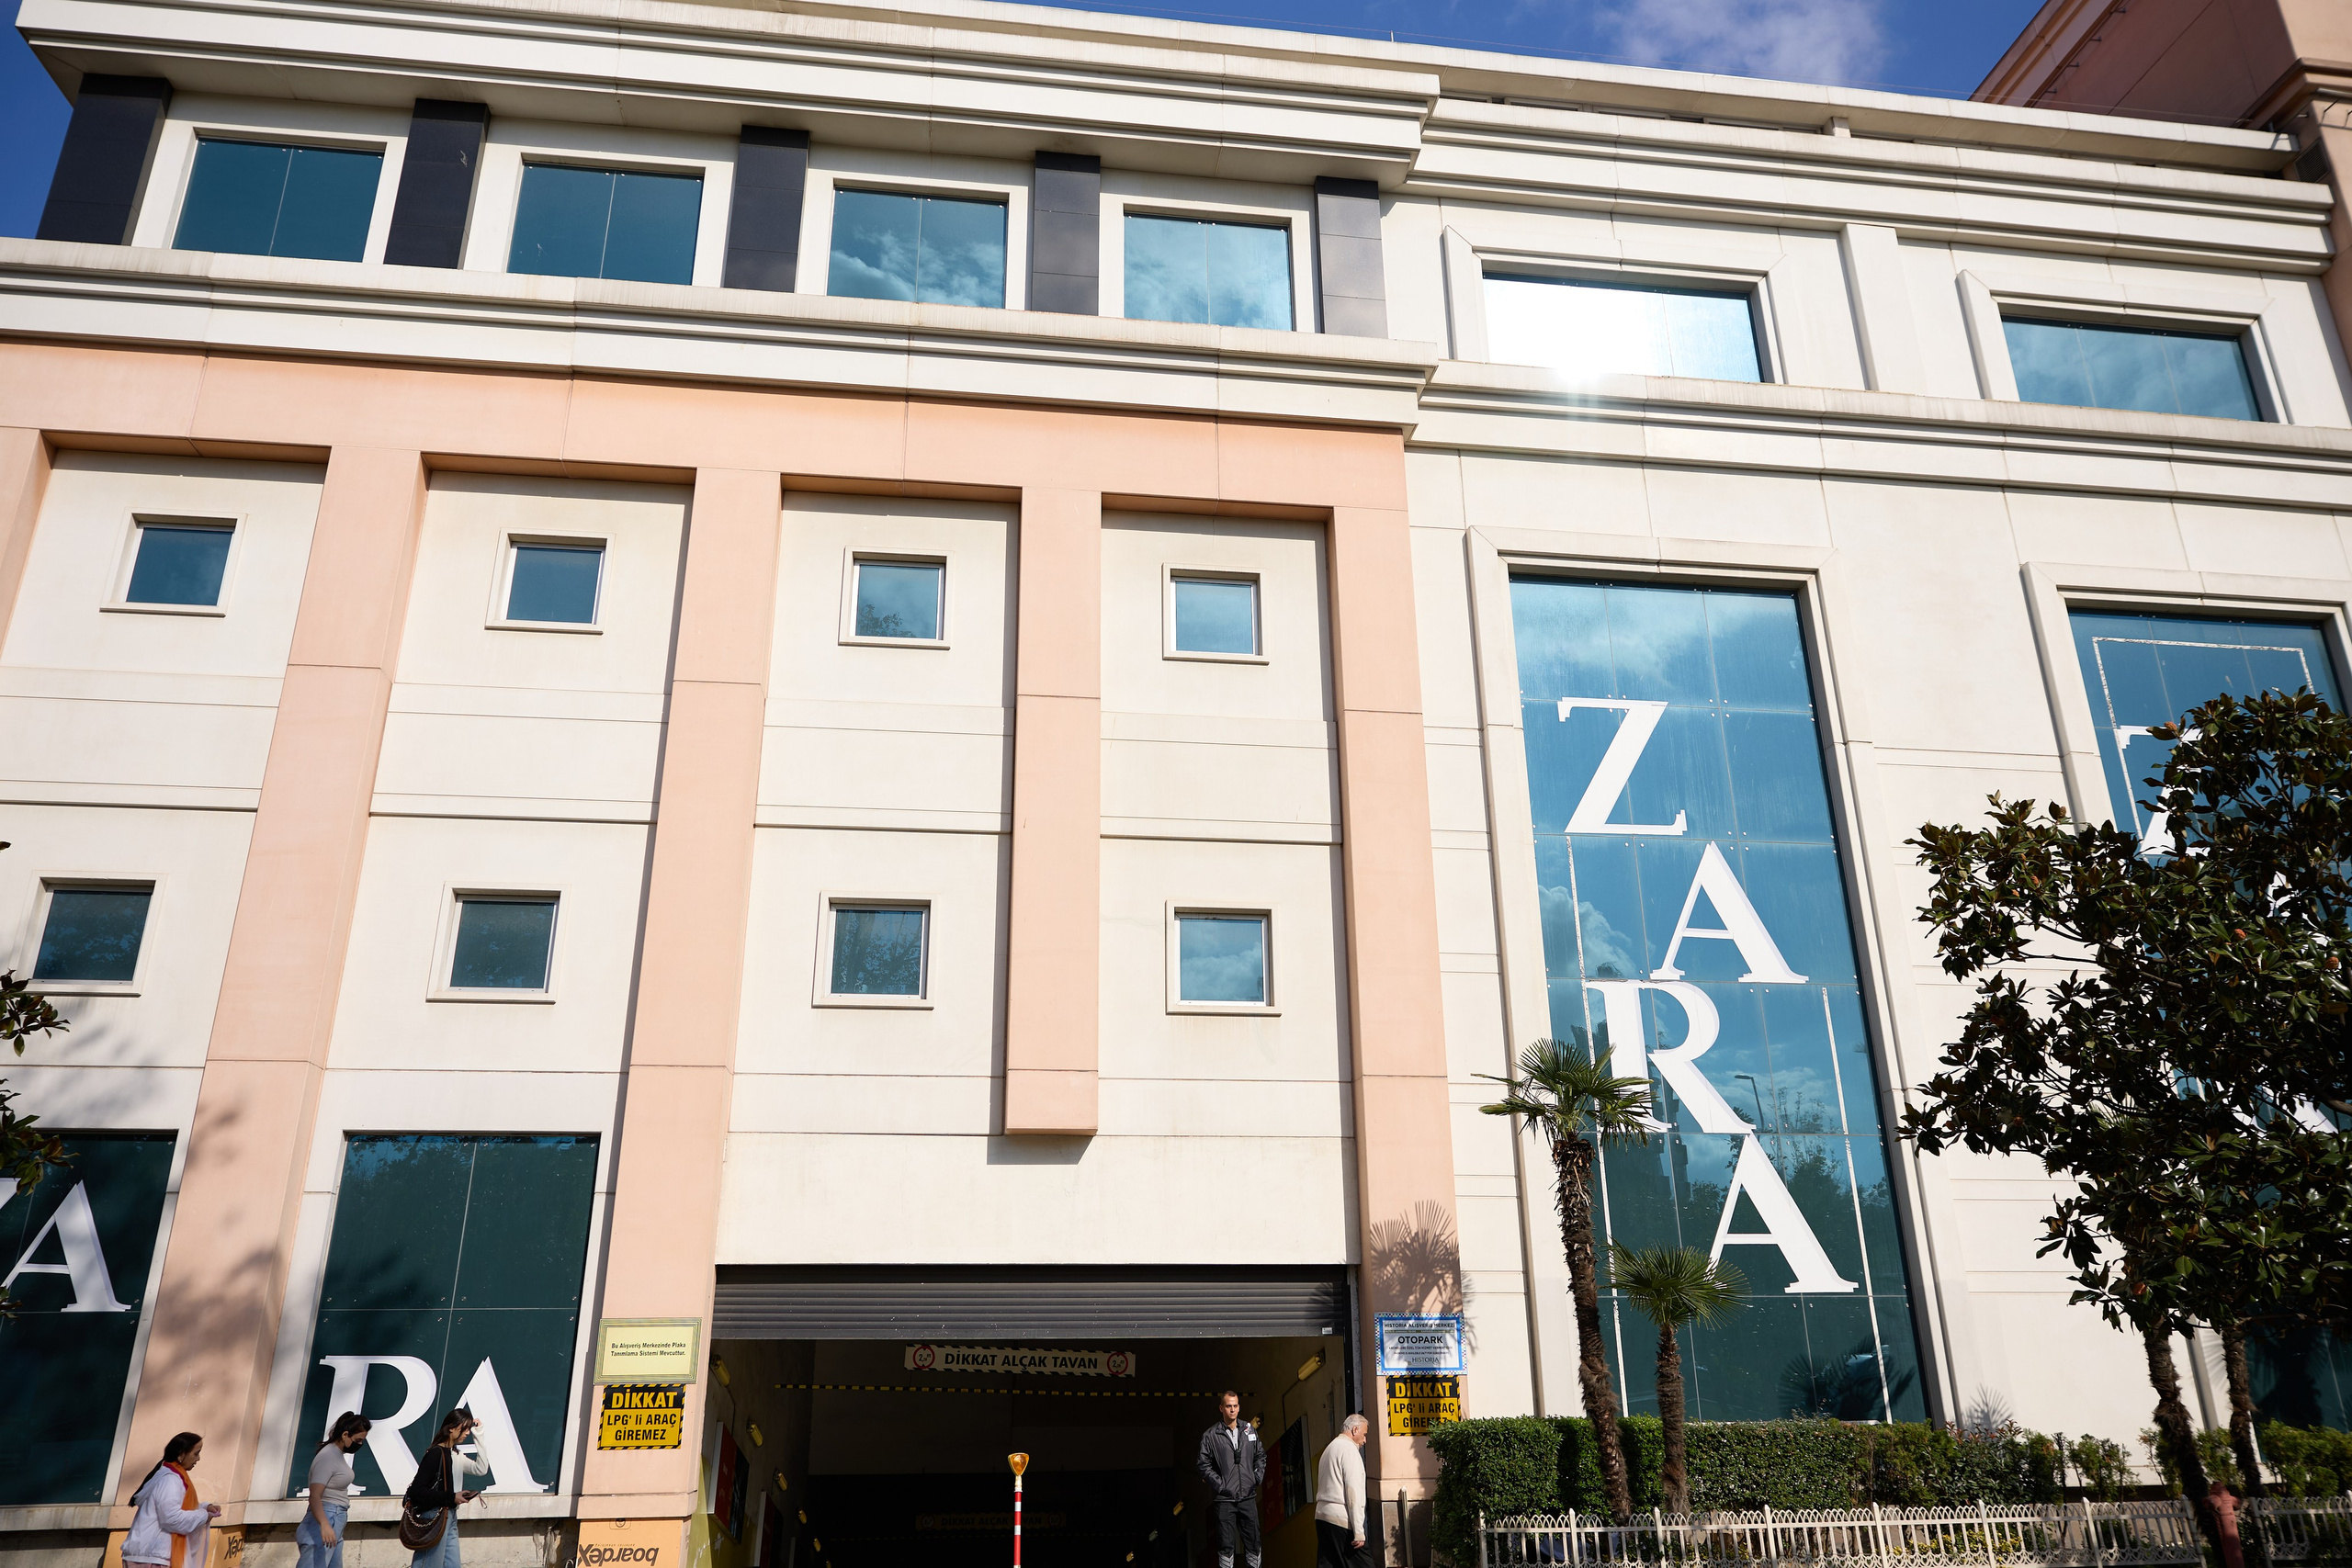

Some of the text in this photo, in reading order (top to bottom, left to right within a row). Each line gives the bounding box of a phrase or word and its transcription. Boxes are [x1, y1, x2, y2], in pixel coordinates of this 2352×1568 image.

[1557, 697, 1859, 1293] ZARA
[0, 1177, 131, 1312] A
[1397, 1336, 1443, 1344] OTOPARK
[944, 1350, 1098, 1371] DİKKAT ALÇAK TAVAN
[1411, 1357, 1440, 1365] HISTORIA
[1395, 1380, 1453, 1398] DİKKAT
[611, 1388, 678, 1408] DİKKAT
[1428, 1403, 1455, 1416] ARAÇ
[646, 1413, 677, 1427] ARAÇ
[615, 1427, 666, 1441] GİREMEZ
